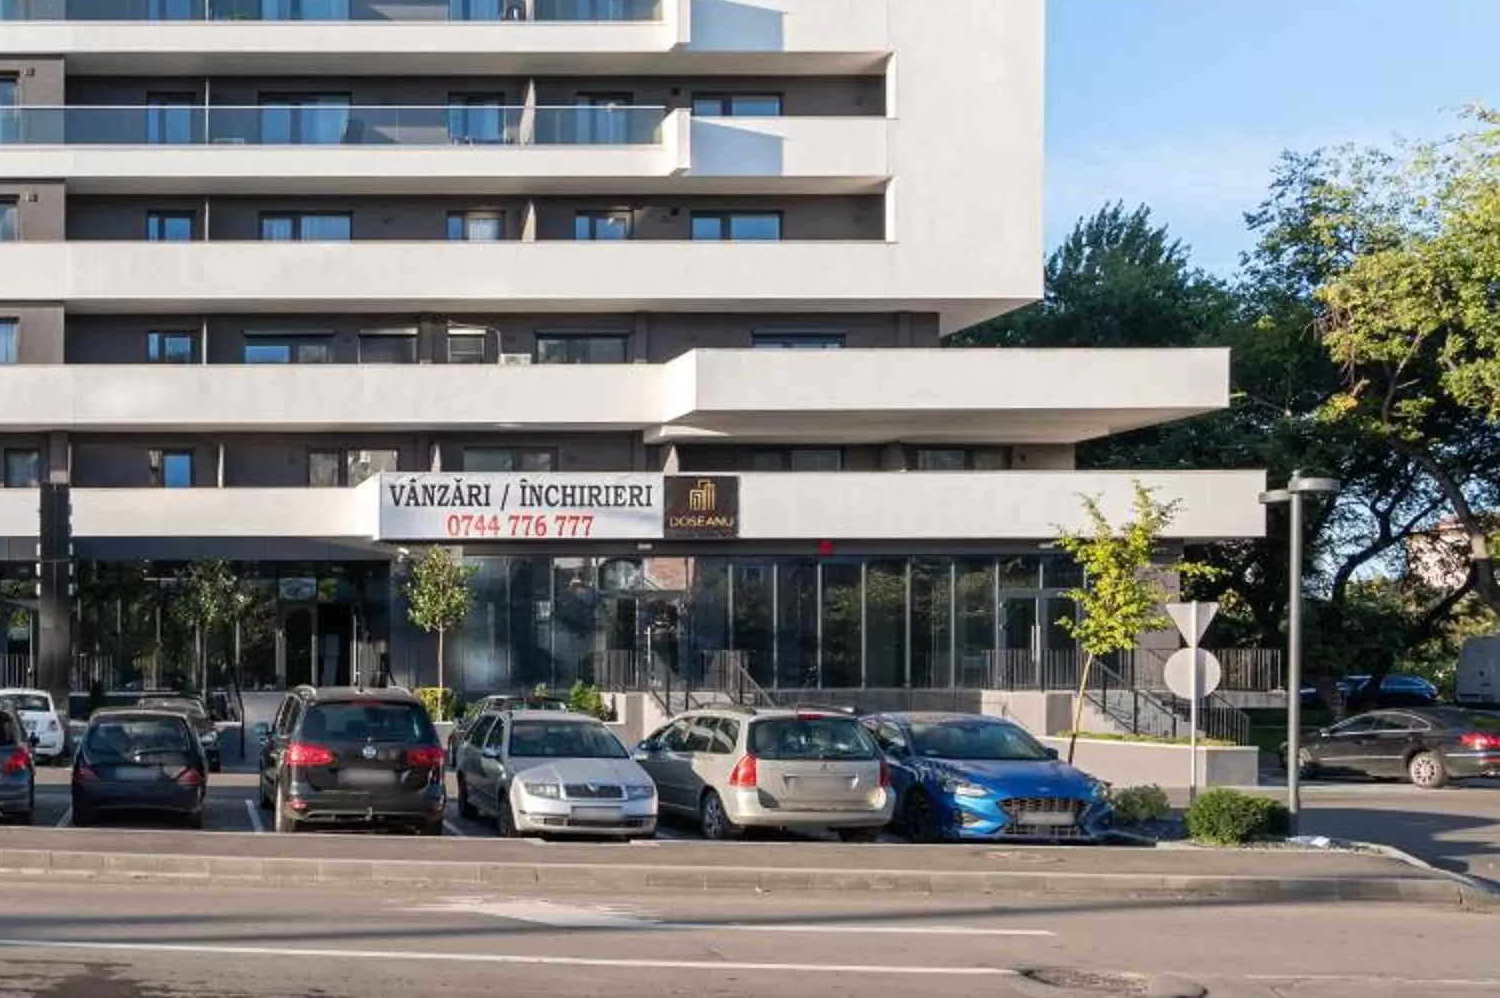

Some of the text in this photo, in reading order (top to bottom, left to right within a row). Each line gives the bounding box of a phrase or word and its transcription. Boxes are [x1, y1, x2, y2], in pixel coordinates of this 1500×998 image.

[389, 479, 653, 511] VÂNZĂRI / ÎNCHIRIERI
[447, 514, 594, 537] 0744 776 777
[669, 515, 734, 527] DOSEANU
